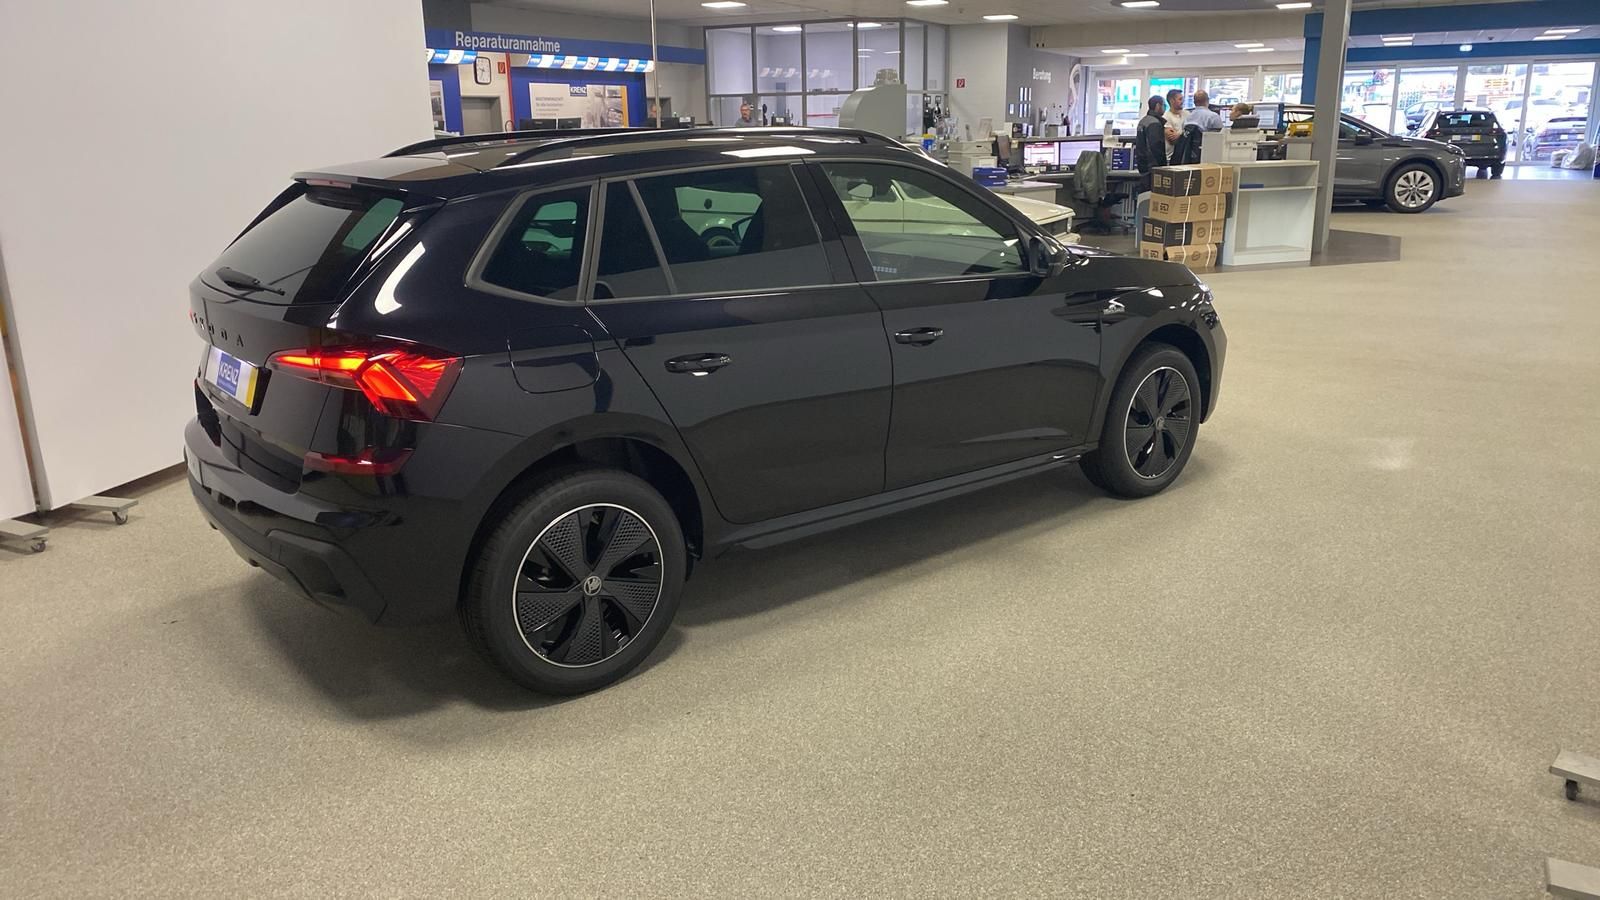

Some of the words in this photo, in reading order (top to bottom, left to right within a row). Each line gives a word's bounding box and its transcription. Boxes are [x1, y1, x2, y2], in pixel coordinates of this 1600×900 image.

[455, 31, 561, 53] Reparaturannahme
[570, 86, 587, 94] KRENZ
[218, 361, 239, 385] KRENZ
